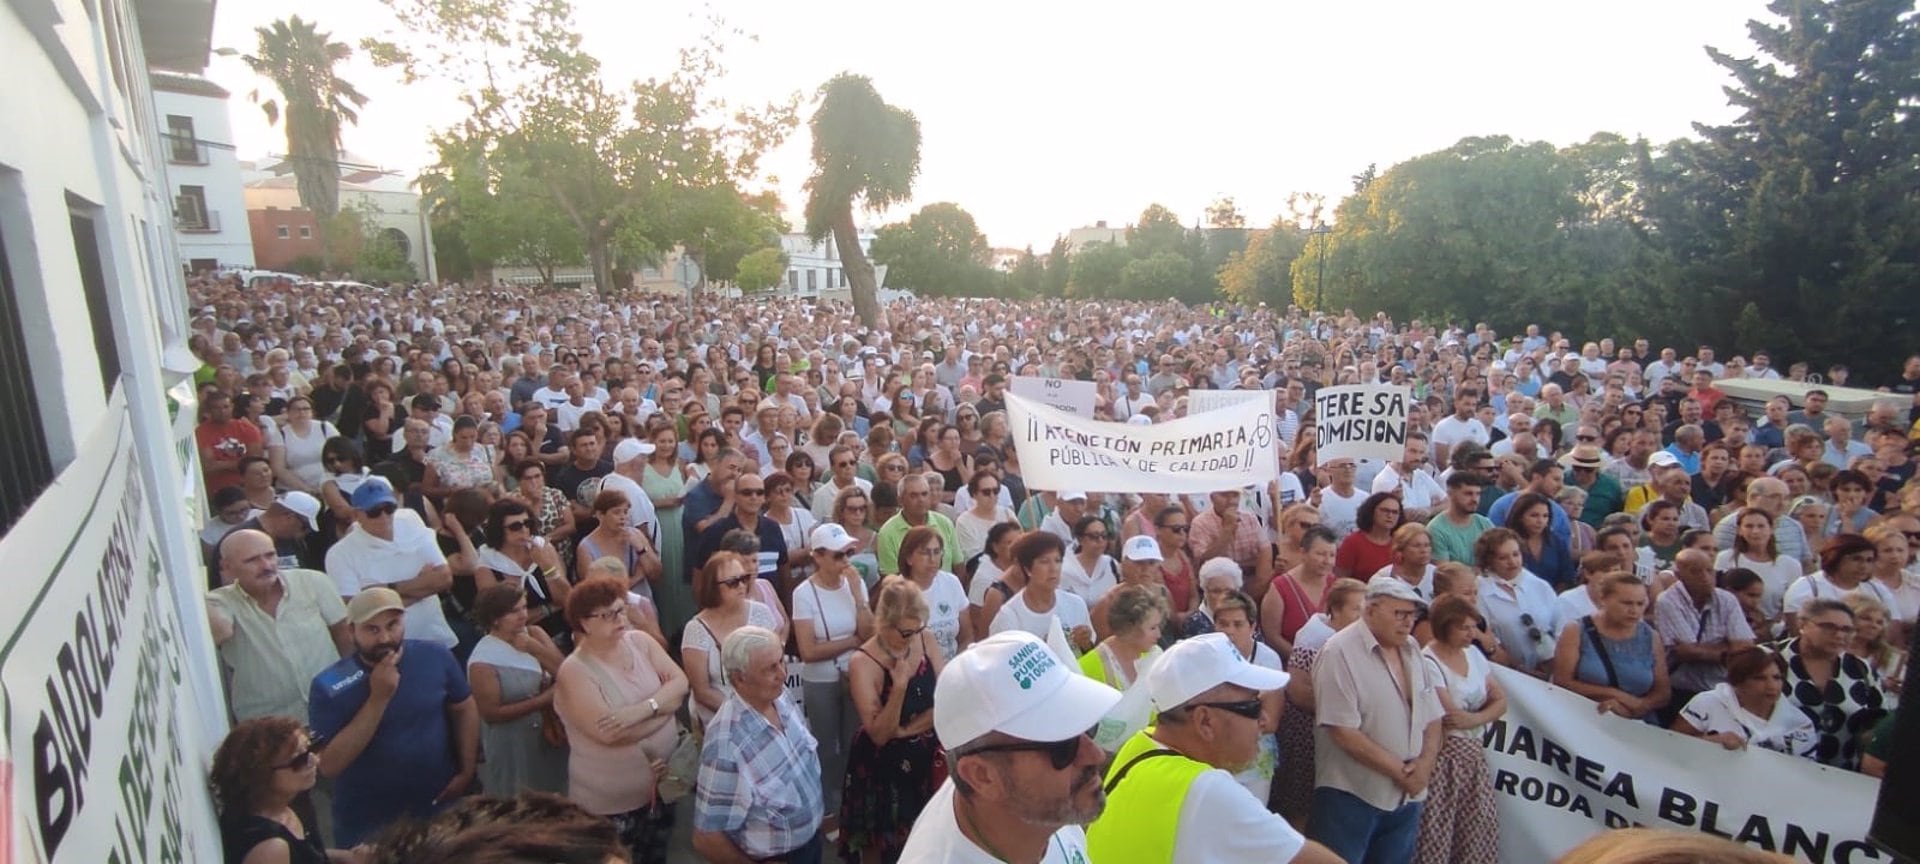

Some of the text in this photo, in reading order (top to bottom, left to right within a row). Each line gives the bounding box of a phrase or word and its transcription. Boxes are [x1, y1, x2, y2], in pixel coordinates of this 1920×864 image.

[1045, 379, 1062, 389] NO
[1150, 426, 1246, 456] PRIMARIA
[1139, 459, 1158, 472] DE
[1169, 454, 1238, 472] CALIDAD
[1483, 719, 1882, 864] MAREA BLANC
[1494, 769, 1594, 819] RODA
